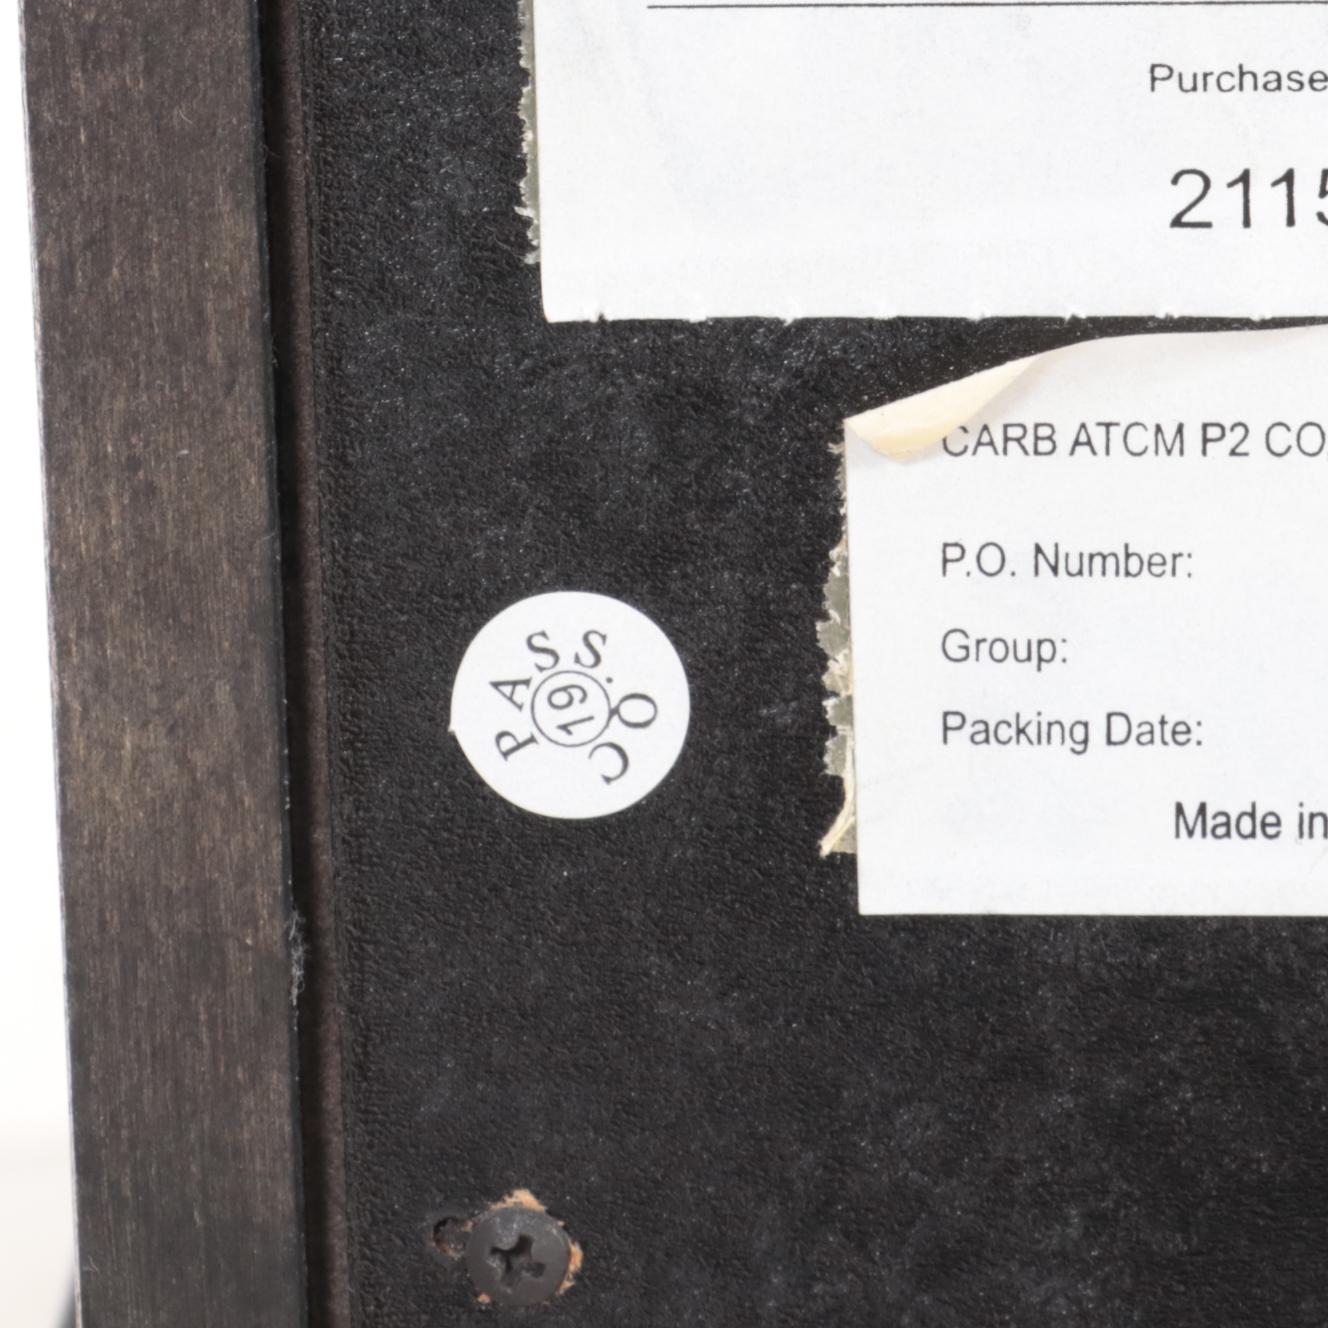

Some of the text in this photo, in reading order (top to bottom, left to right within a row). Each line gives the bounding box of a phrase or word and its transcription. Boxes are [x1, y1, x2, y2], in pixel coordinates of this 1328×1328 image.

[1150, 64, 1328, 93] Purchase
[942, 423, 1057, 457] CARB
[1069, 422, 1184, 456] ATCM
[1202, 422, 1249, 457] P2
[942, 542, 1015, 577] P.O.
[1034, 543, 1191, 577] Number:
[942, 629, 1066, 672] Group:
[943, 711, 1089, 755] Packing
[1106, 712, 1202, 746] Date:
[1175, 801, 1281, 840] Made
[1298, 802, 1328, 839] in
